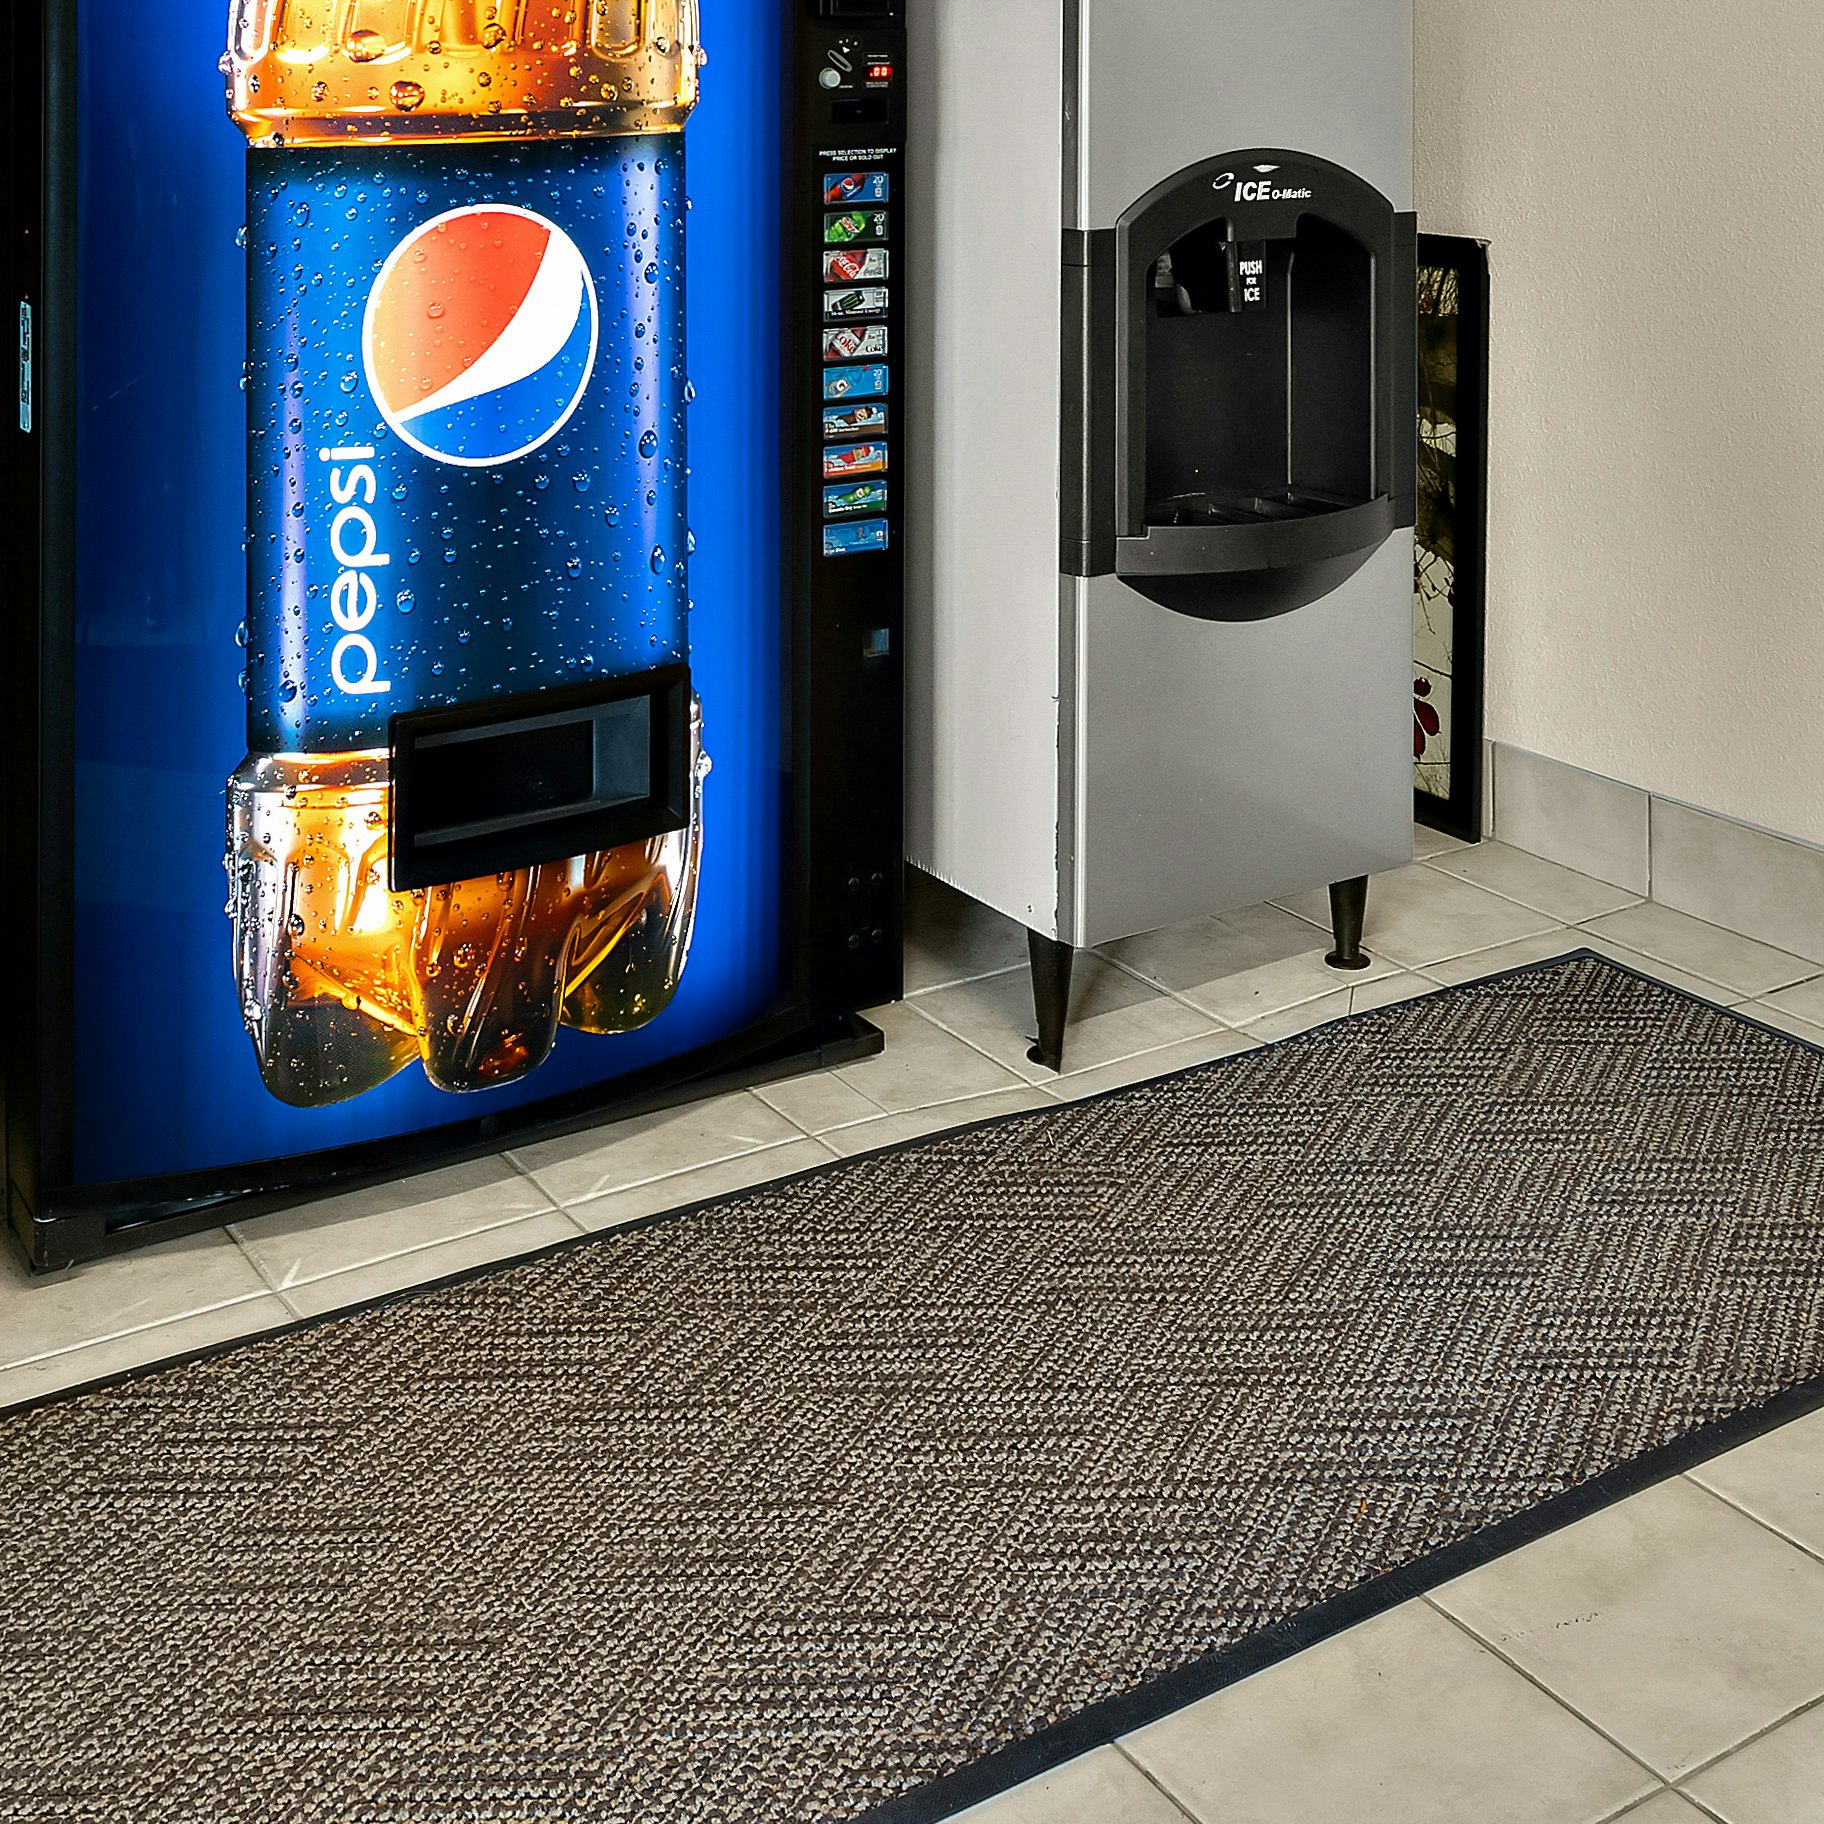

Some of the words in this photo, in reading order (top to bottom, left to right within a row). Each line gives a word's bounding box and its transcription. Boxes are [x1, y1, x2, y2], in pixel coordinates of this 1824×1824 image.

[873, 176, 884, 184] 20
[1234, 181, 1272, 202] ICE
[873, 214, 884, 222] 20
[1239, 259, 1263, 275] PUSH
[1246, 276, 1257, 285] FOR
[1244, 287, 1260, 302] ICE
[319, 445, 391, 695] pepsi
